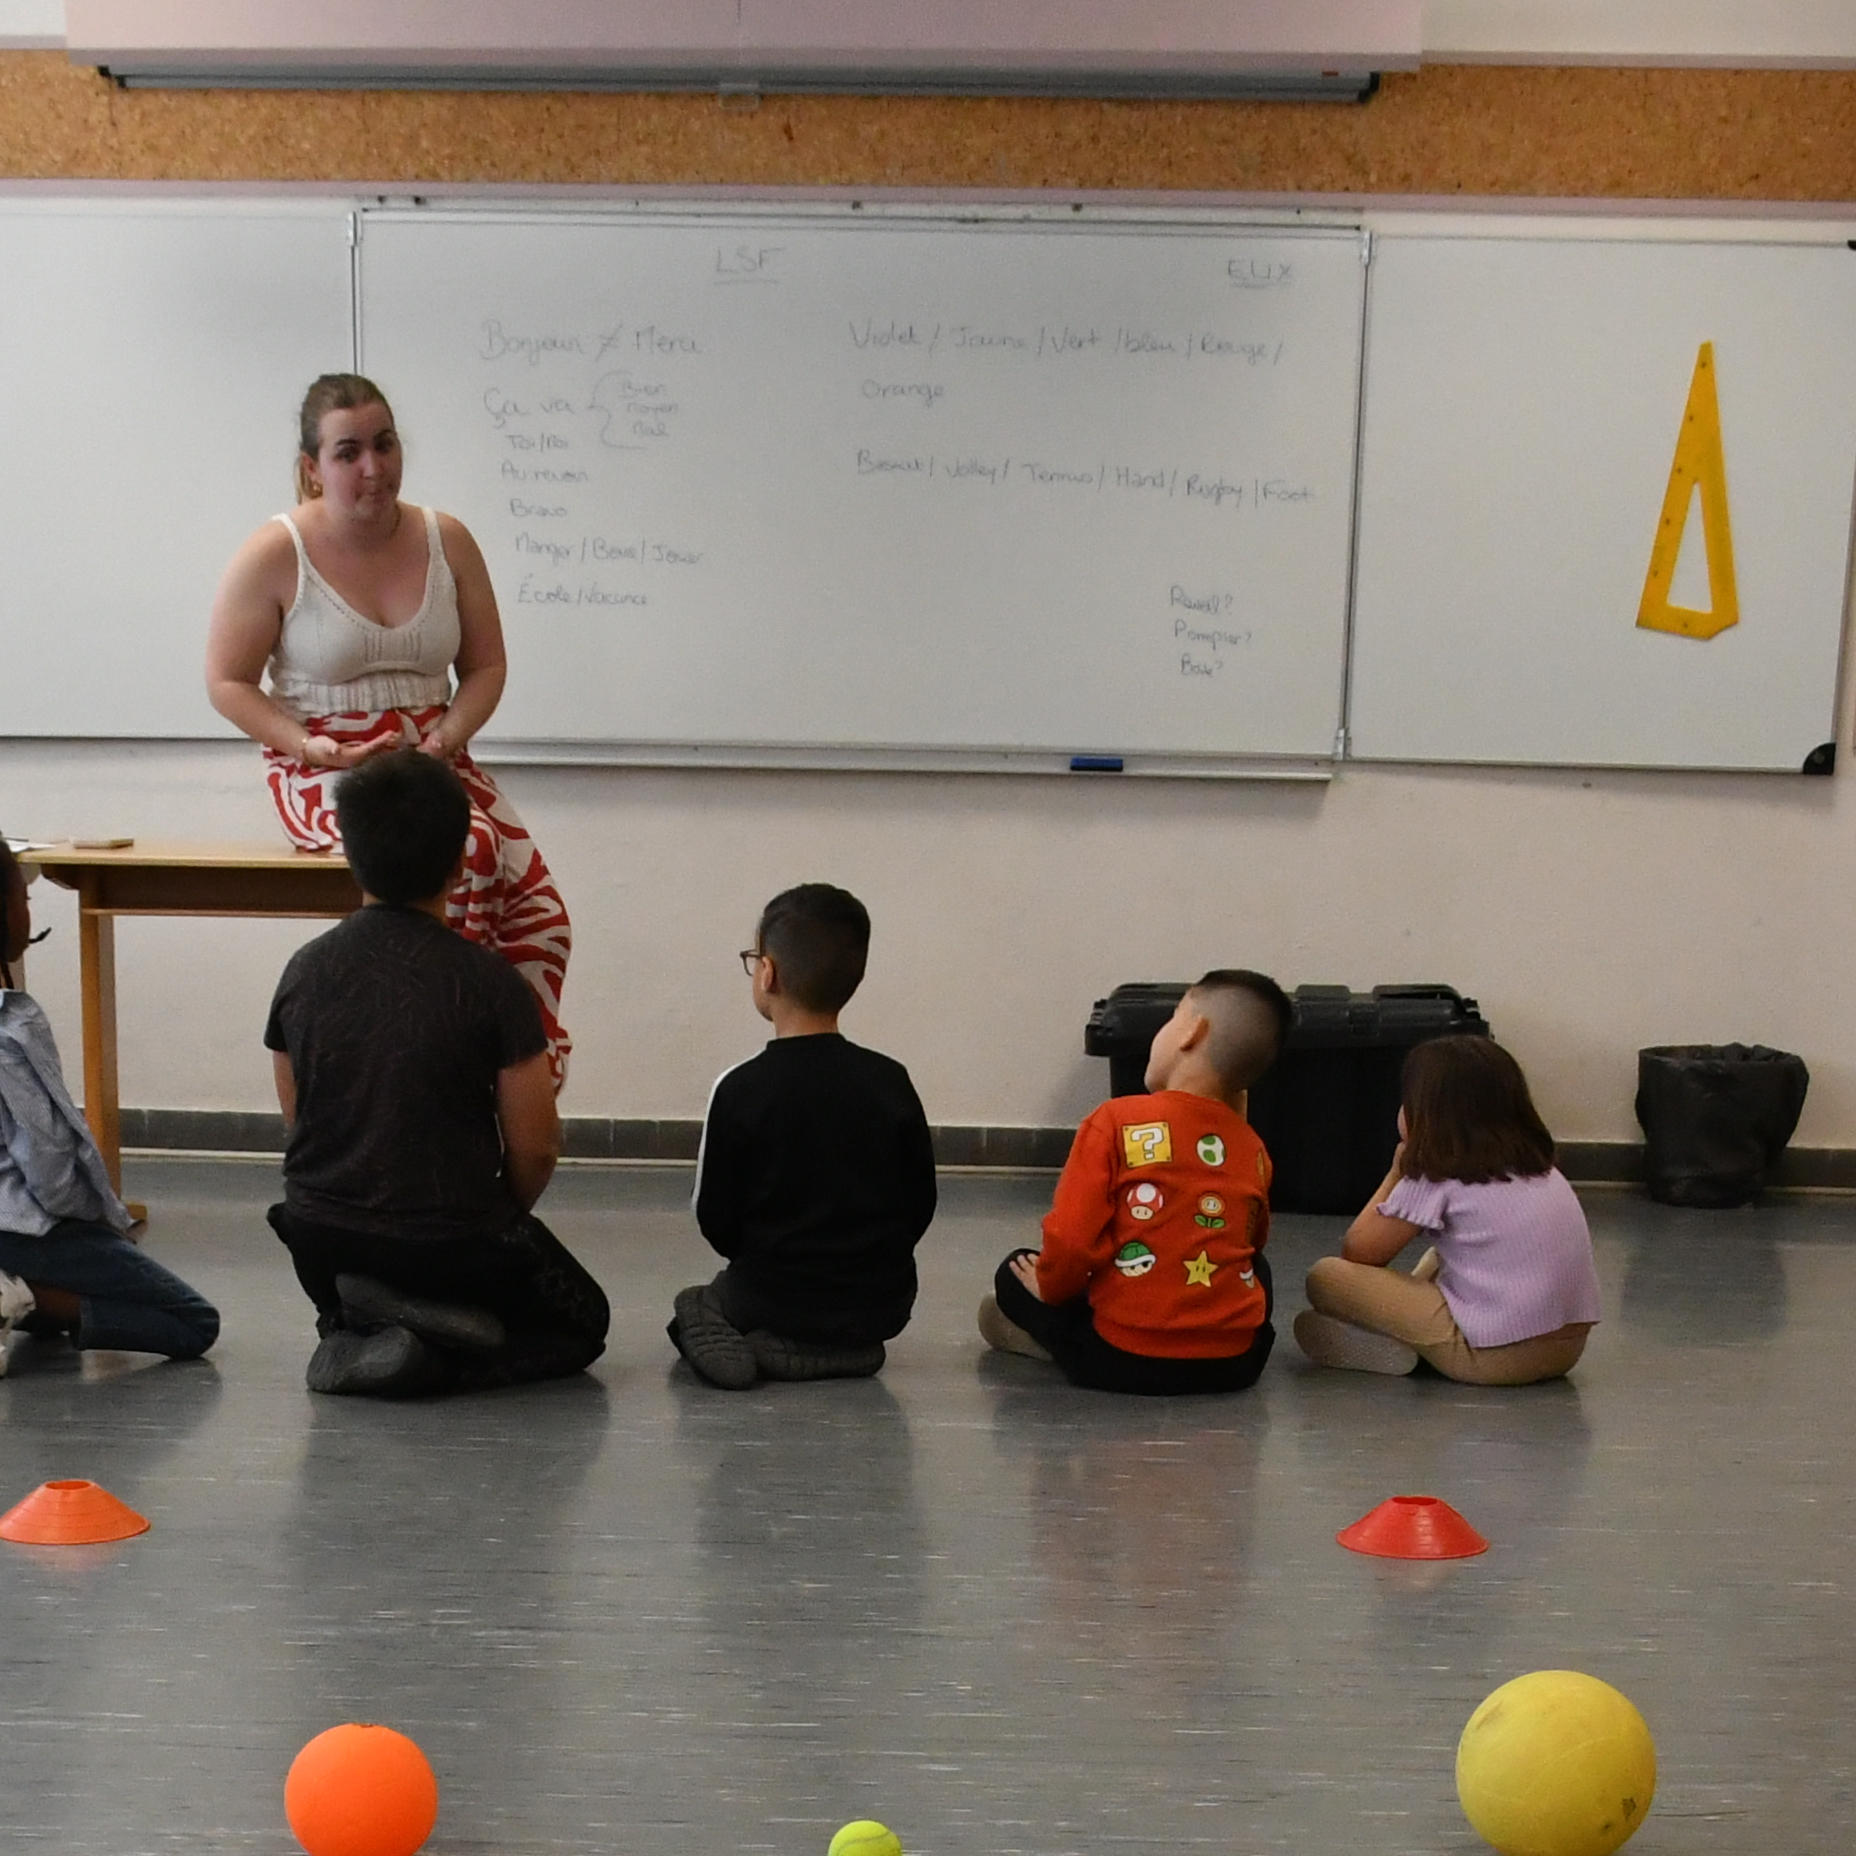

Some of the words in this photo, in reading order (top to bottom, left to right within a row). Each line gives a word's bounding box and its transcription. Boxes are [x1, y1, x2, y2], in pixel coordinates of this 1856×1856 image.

[716, 245, 787, 273] LSF
[479, 318, 584, 366] Bonjour
[632, 324, 702, 354] Merci
[848, 318, 922, 348] Violet
[1050, 326, 1102, 354] Vert
[483, 387, 527, 429] Ça
[539, 398, 575, 415] va
[861, 377, 945, 408] Orange
[1116, 465, 1165, 488] Hand
[510, 498, 567, 517] Bravo
